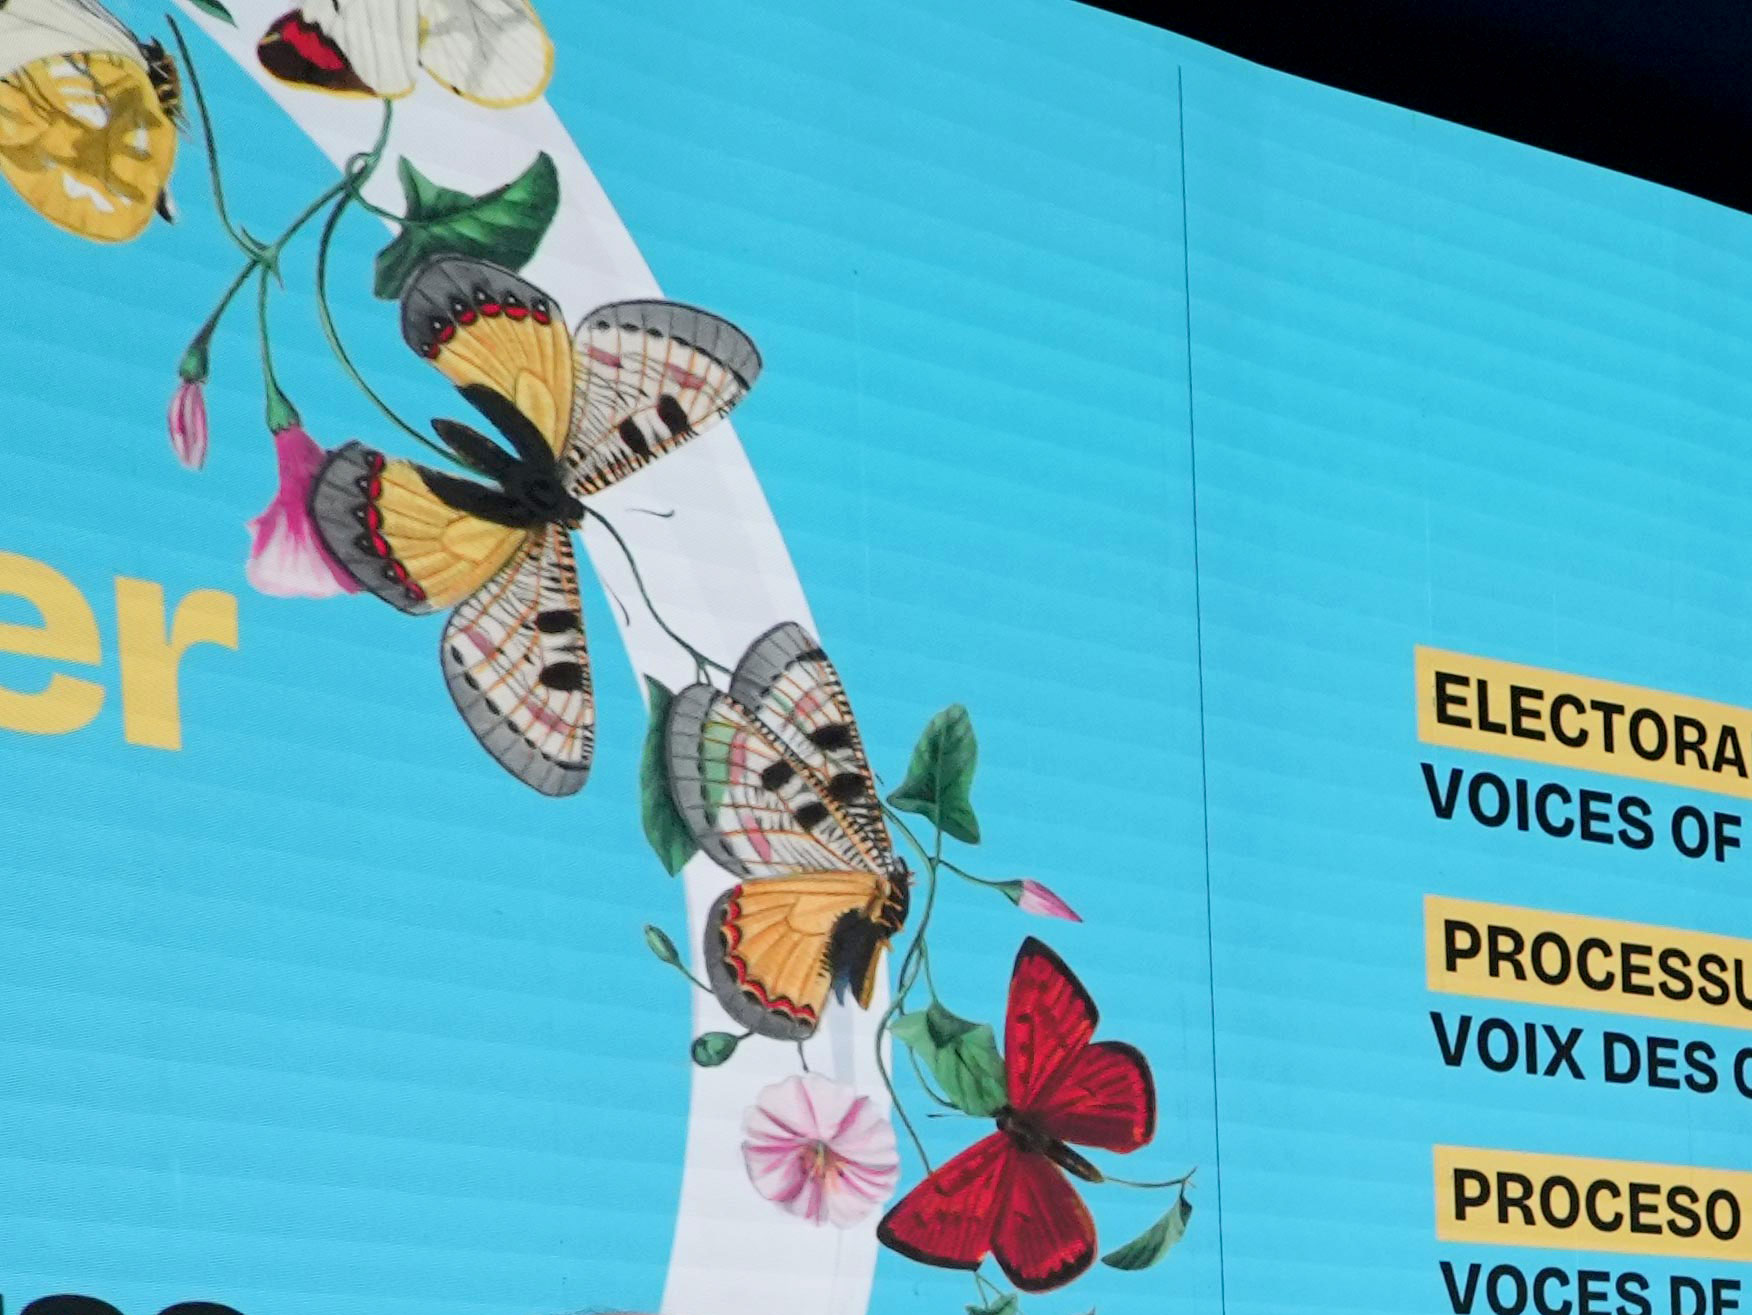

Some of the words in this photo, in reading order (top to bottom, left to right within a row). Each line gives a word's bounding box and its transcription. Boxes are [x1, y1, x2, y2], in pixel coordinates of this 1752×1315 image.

[1420, 762, 1655, 850] VOICES
[1671, 805, 1742, 862] OF
[1429, 1012, 1587, 1080] VOIX
[1603, 1033, 1718, 1093] DES
[1452, 1168, 1741, 1244] PROCESO
